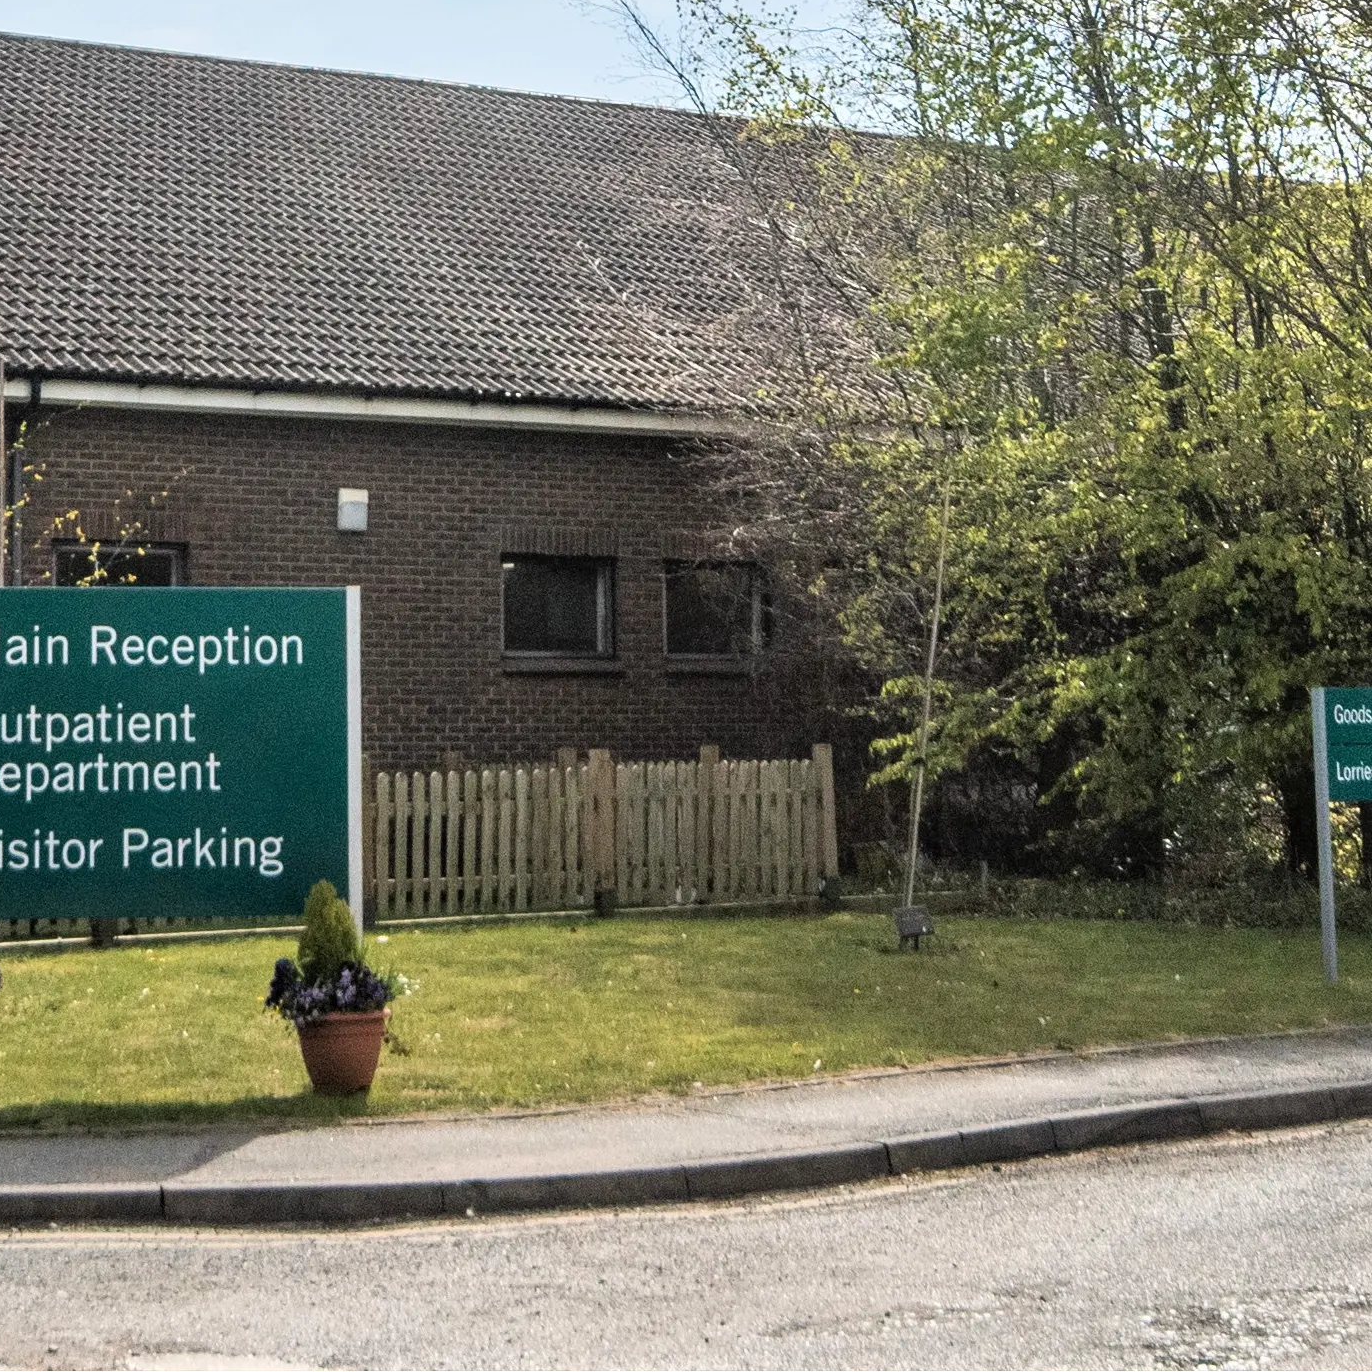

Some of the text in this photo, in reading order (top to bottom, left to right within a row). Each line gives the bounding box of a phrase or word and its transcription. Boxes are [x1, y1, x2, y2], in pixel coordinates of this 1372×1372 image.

[91, 625, 303, 675] Reception
[1333, 704, 1372, 724] Goods
[1335, 760, 1372, 781] Lorrie
[123, 828, 284, 877] Parking
